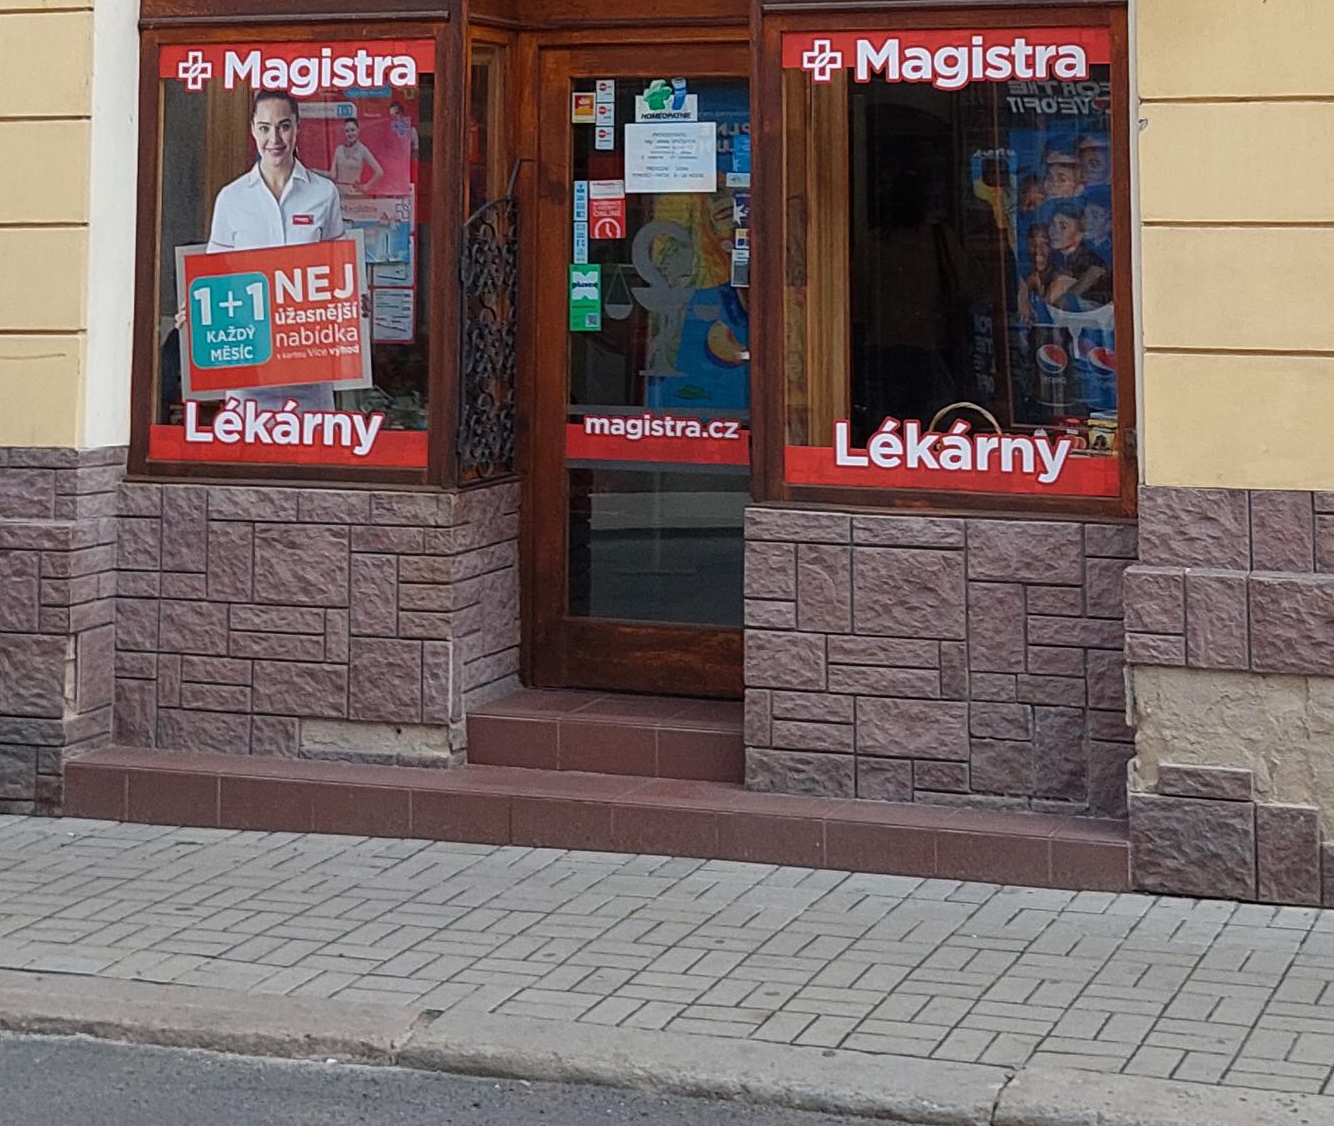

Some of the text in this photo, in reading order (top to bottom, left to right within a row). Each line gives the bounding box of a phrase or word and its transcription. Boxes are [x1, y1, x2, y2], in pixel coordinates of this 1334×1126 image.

[224, 47, 417, 94] Magistra
[857, 36, 1088, 88] Magistra
[193, 282, 265, 326] 1+1
[274, 263, 354, 304] NEJ
[206, 325, 257, 343] KAŽDÝ
[275, 301, 358, 326] úžasnější
[210, 344, 253, 362] MĚSÍC
[275, 324, 359, 348] nabídka
[184, 397, 384, 455] Lékárny
[584, 415, 739, 441] magistra.cz
[835, 416, 1071, 482] Lékárny
